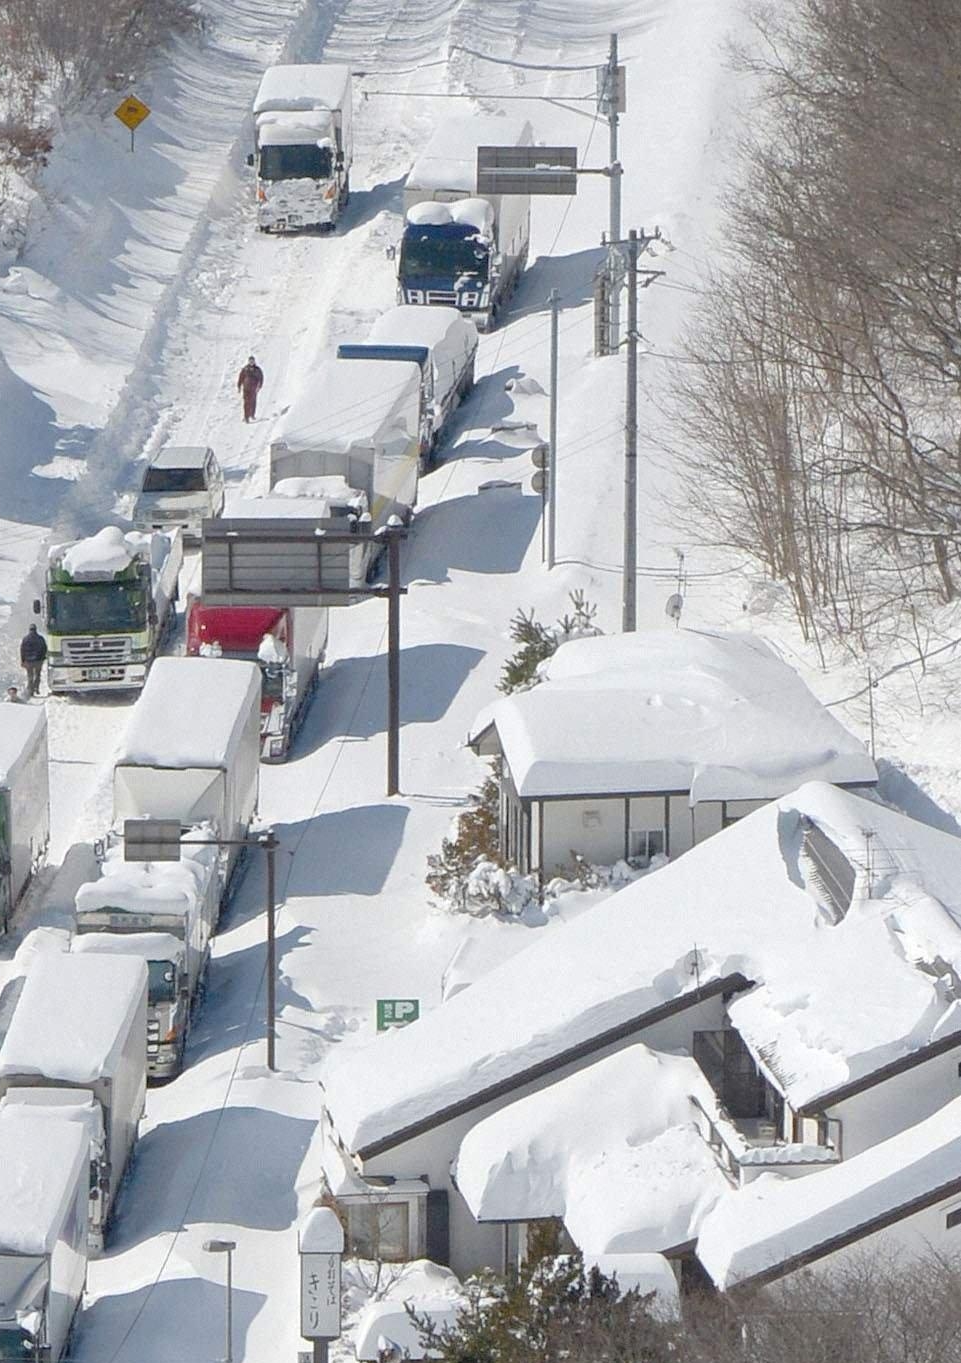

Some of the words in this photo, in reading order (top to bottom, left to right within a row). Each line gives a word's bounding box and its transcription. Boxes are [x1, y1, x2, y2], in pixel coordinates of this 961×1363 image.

[395, 1002, 415, 1019] P
[308, 1272, 320, 1329] きこり
